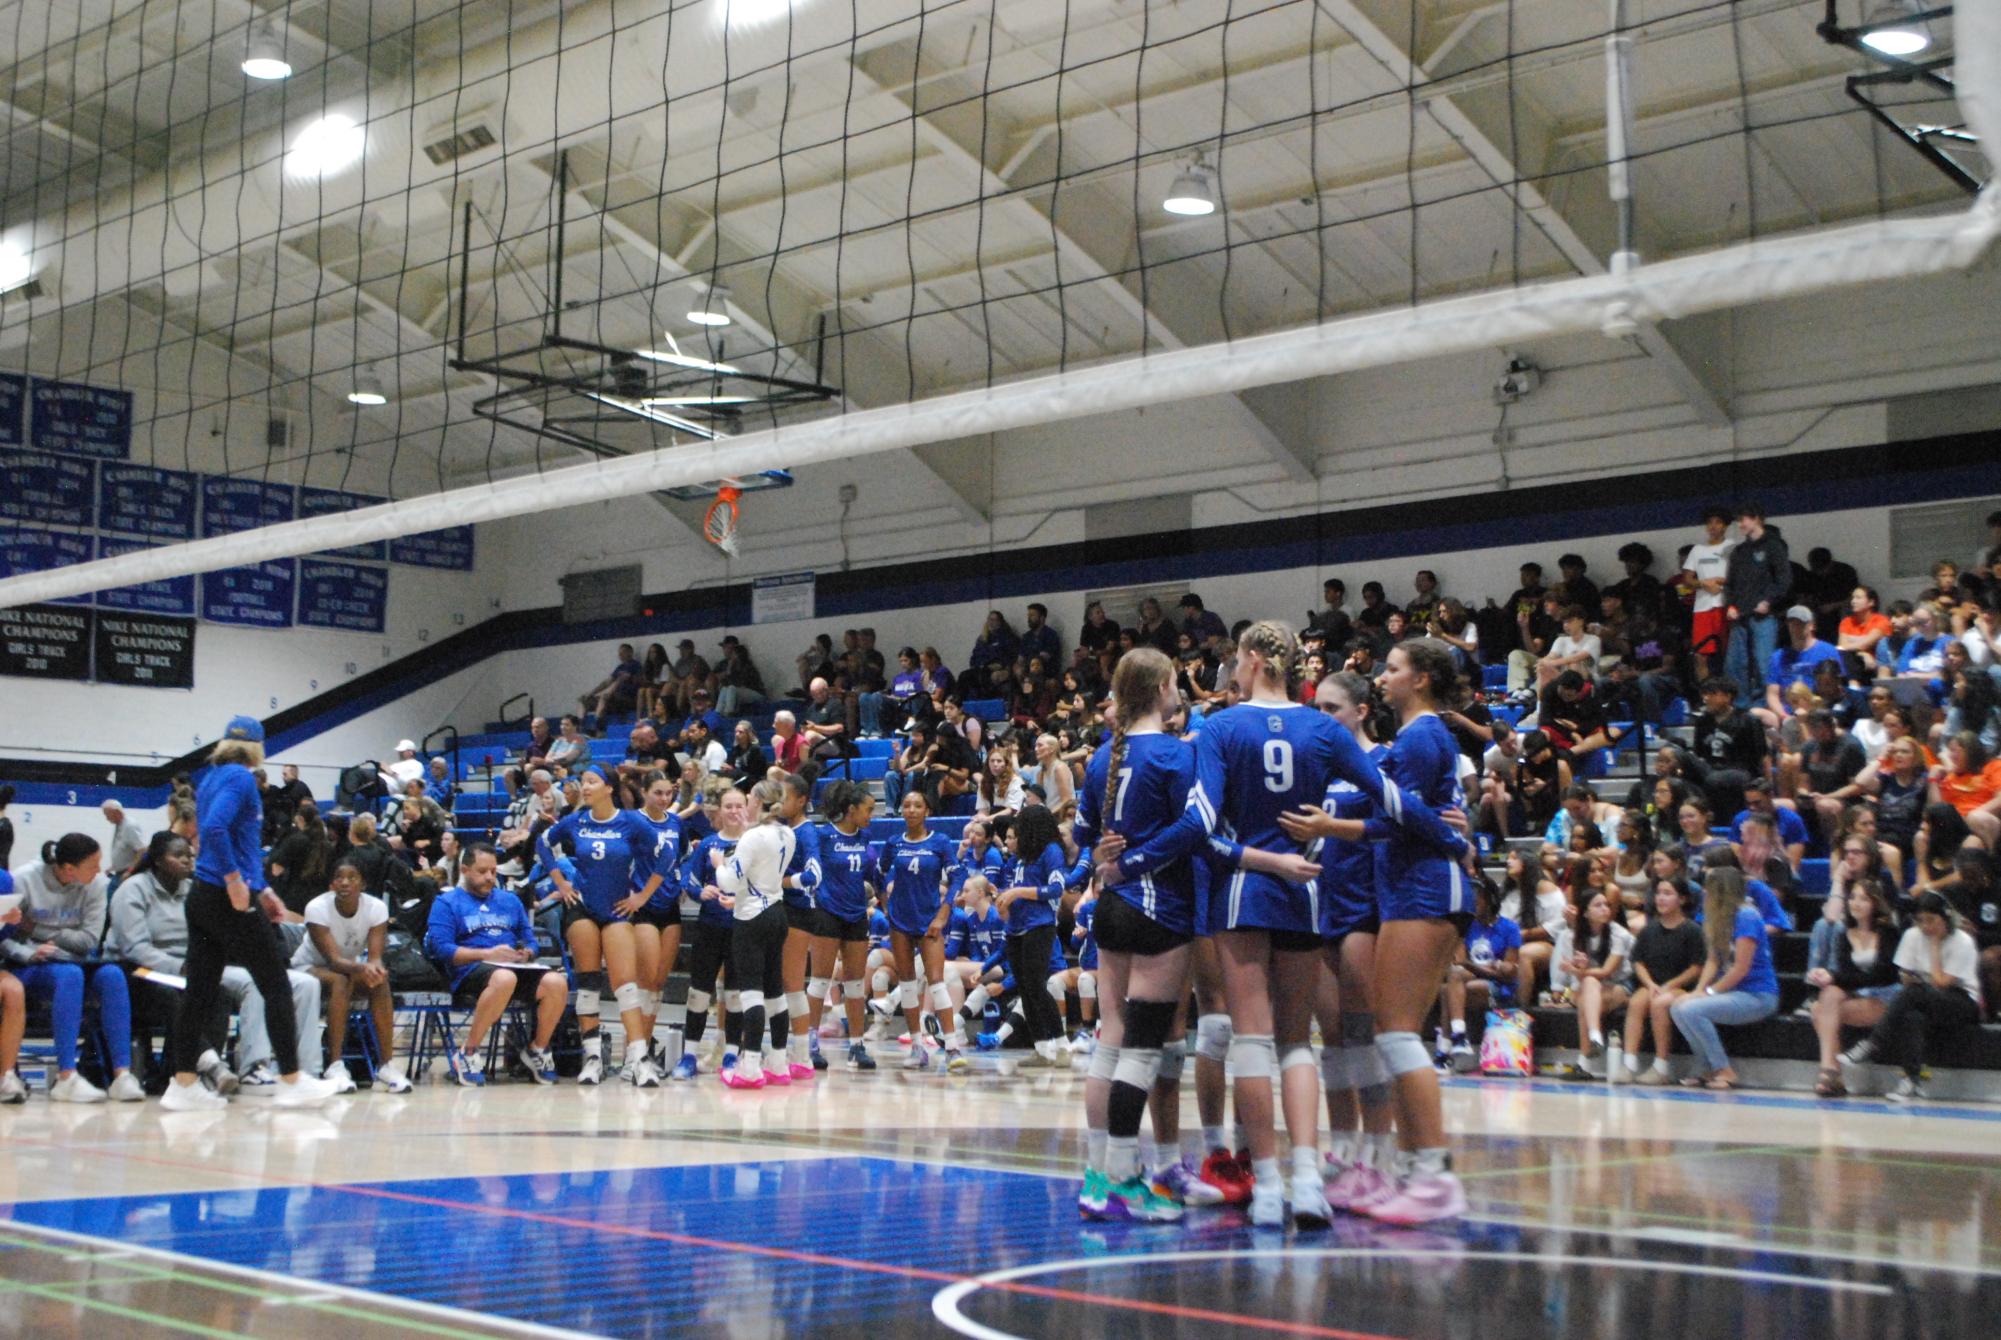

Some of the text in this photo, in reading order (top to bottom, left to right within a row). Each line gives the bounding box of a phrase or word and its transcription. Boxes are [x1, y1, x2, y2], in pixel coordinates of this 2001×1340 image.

[25, 612, 85, 629] NATIONAL
[3, 624, 79, 642] CHAMPIONS
[102, 619, 189, 639] NIKE NATIONAL
[417, 628, 430, 642] 12
[8, 641, 35, 655] GIRLS
[110, 634, 182, 651] CHAMPIONS
[116, 652, 141, 665] GIRLS
[345, 661, 358, 676] 10
[1263, 739, 1295, 794] 9
[106, 770, 118, 785] 4
[65, 789, 78, 805] 3
[1115, 767, 1133, 822] 7
[24, 811, 33, 824] 2
[578, 827, 622, 839] Chandler
[591, 840, 606, 860] 3
[834, 842, 866, 852] Chandler
[847, 853, 862, 873] 11
[907, 857, 920, 875] 4
